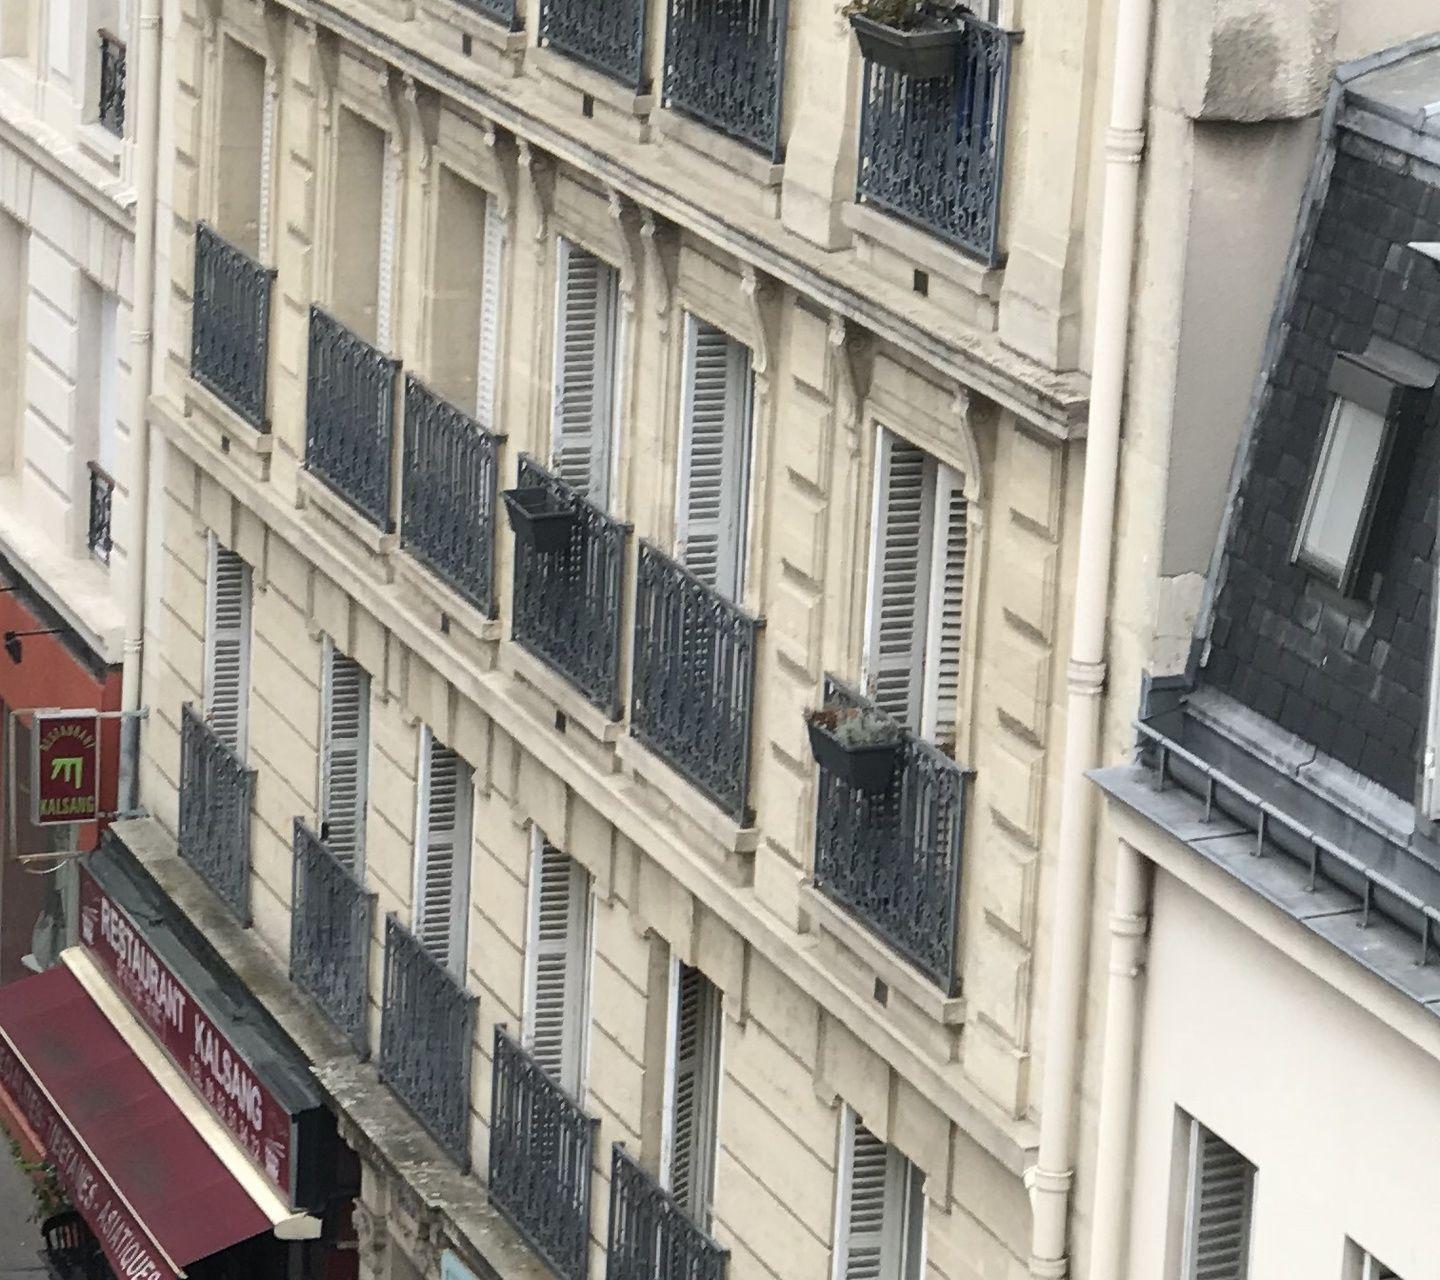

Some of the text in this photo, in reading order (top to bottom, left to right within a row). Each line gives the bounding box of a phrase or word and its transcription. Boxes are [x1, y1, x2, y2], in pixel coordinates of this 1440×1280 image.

[40, 795, 95, 816] KALSANG
[101, 895, 187, 1034] RESTAURANT
[194, 1013, 263, 1132] KALSANG
